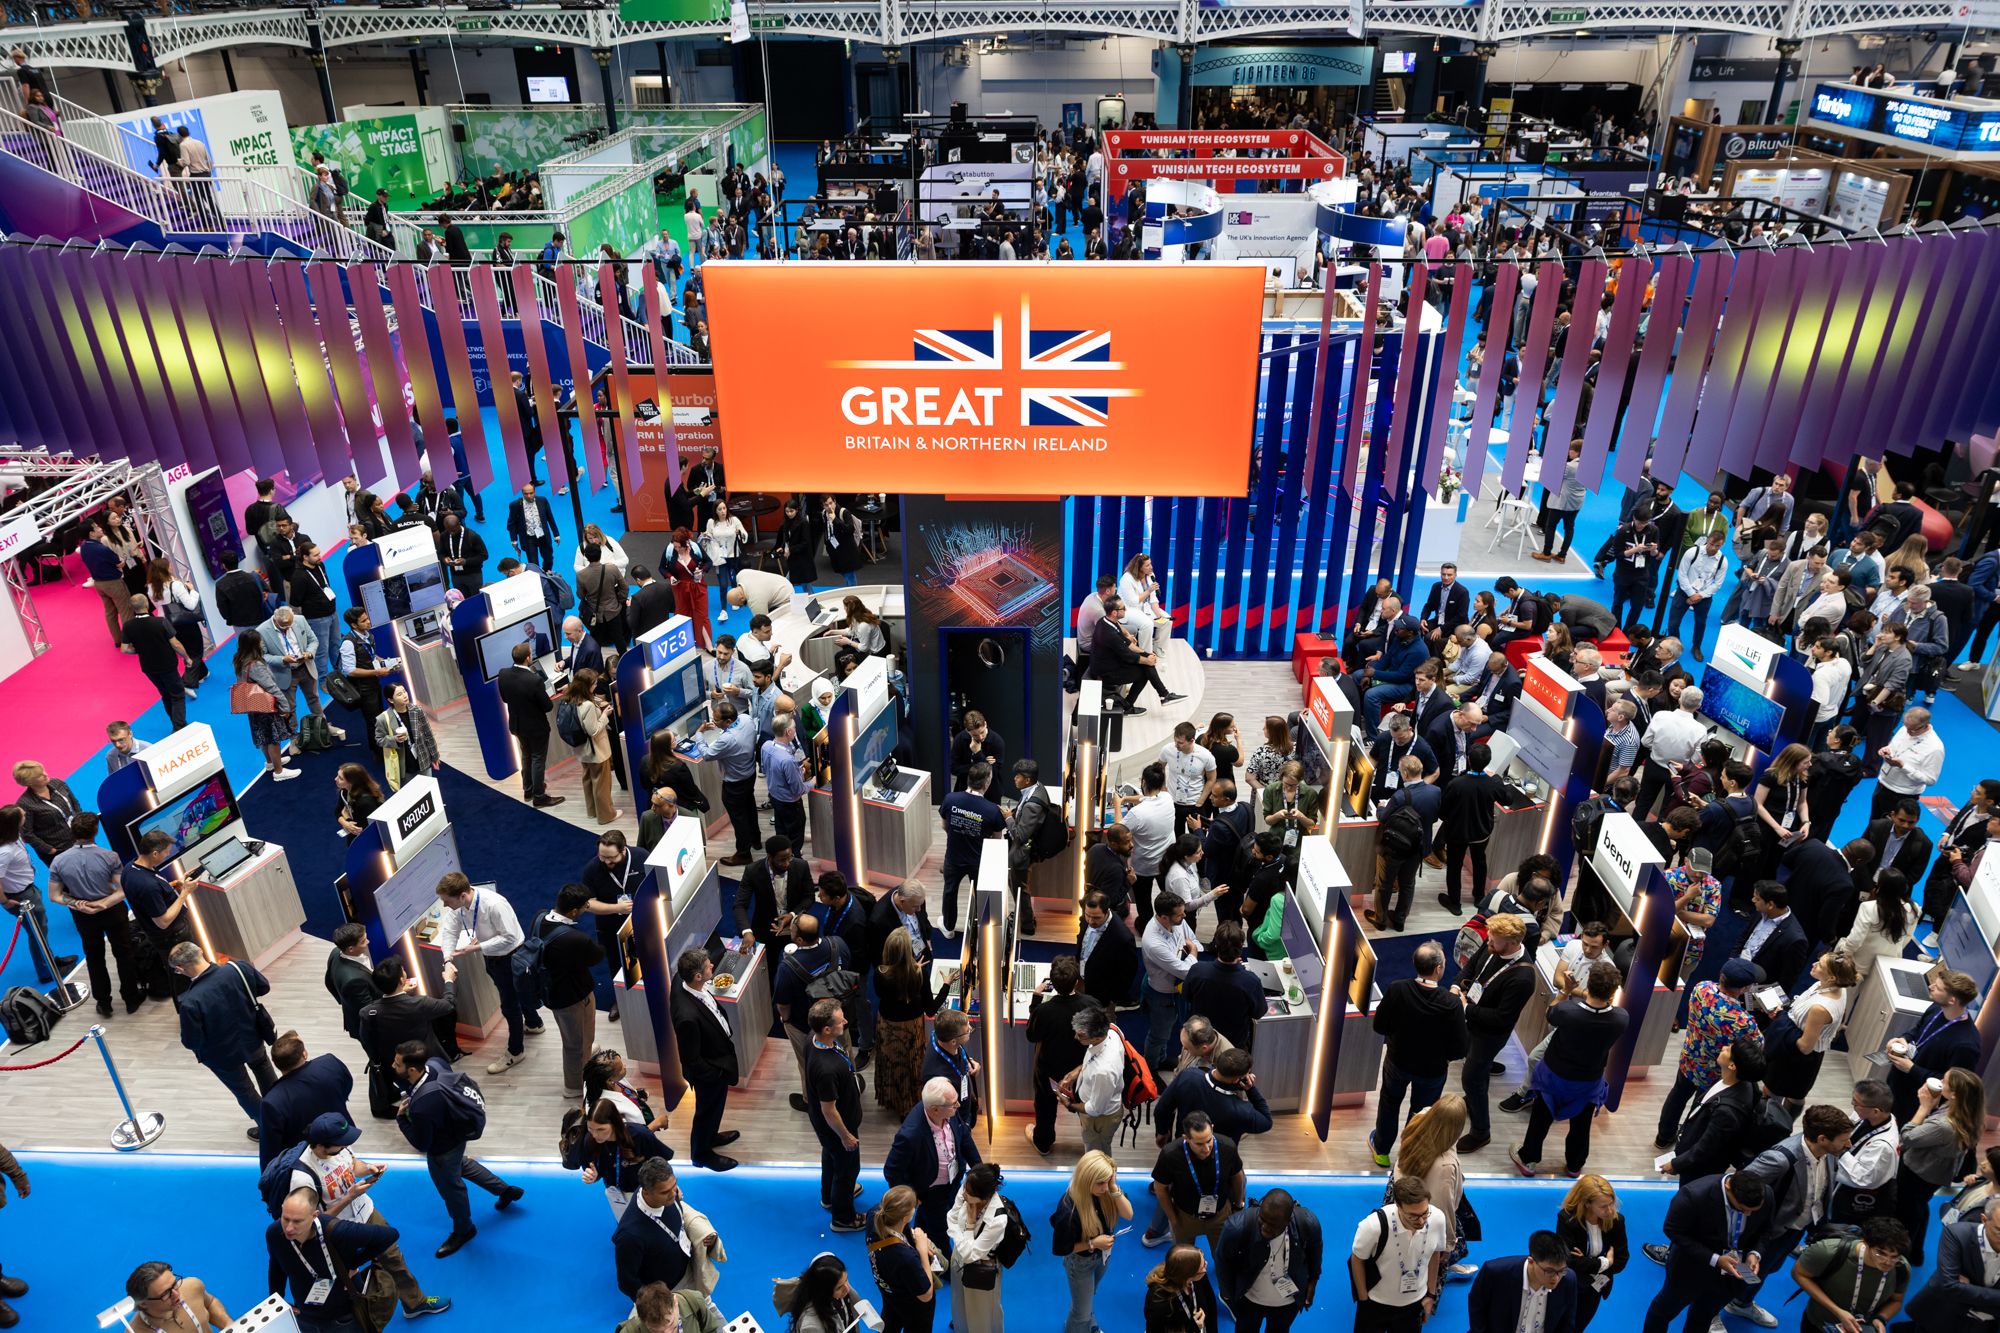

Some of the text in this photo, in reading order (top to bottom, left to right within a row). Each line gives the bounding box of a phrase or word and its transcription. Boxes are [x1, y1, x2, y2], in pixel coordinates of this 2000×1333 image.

[1234, 65, 1317, 81] EIGHTEEN 86
[1718, 66, 1735, 76] Lift
[251, 110, 263, 118] TECH
[1817, 94, 1852, 119] Türkiye
[1900, 103, 1909, 113] OF
[255, 115, 269, 123] WEEK
[1911, 117, 1938, 130] FEMALE
[229, 131, 273, 156] IMPACT
[368, 127, 414, 145] IMPACT
[1140, 134, 1270, 144] TUNISIAN TECH ECOSYSTEM
[380, 140, 418, 157] STAGE
[1152, 163, 1301, 174] TUNISIAN TECH ECOSYSTEM
[1286, 234, 1309, 242] Agency
[841, 386, 1003, 426] GREAT
[637, 431, 655, 440] RM
[639, 444, 656, 452] ata
[845, 436, 1108, 451] BRITAIN & NORTHERN IRELAND
[1720, 707, 1750, 729] pureLiFi
[158, 741, 210, 777] MAXRES
[402, 799, 430, 832] KAIKU
[1603, 830, 1633, 880] bendi
